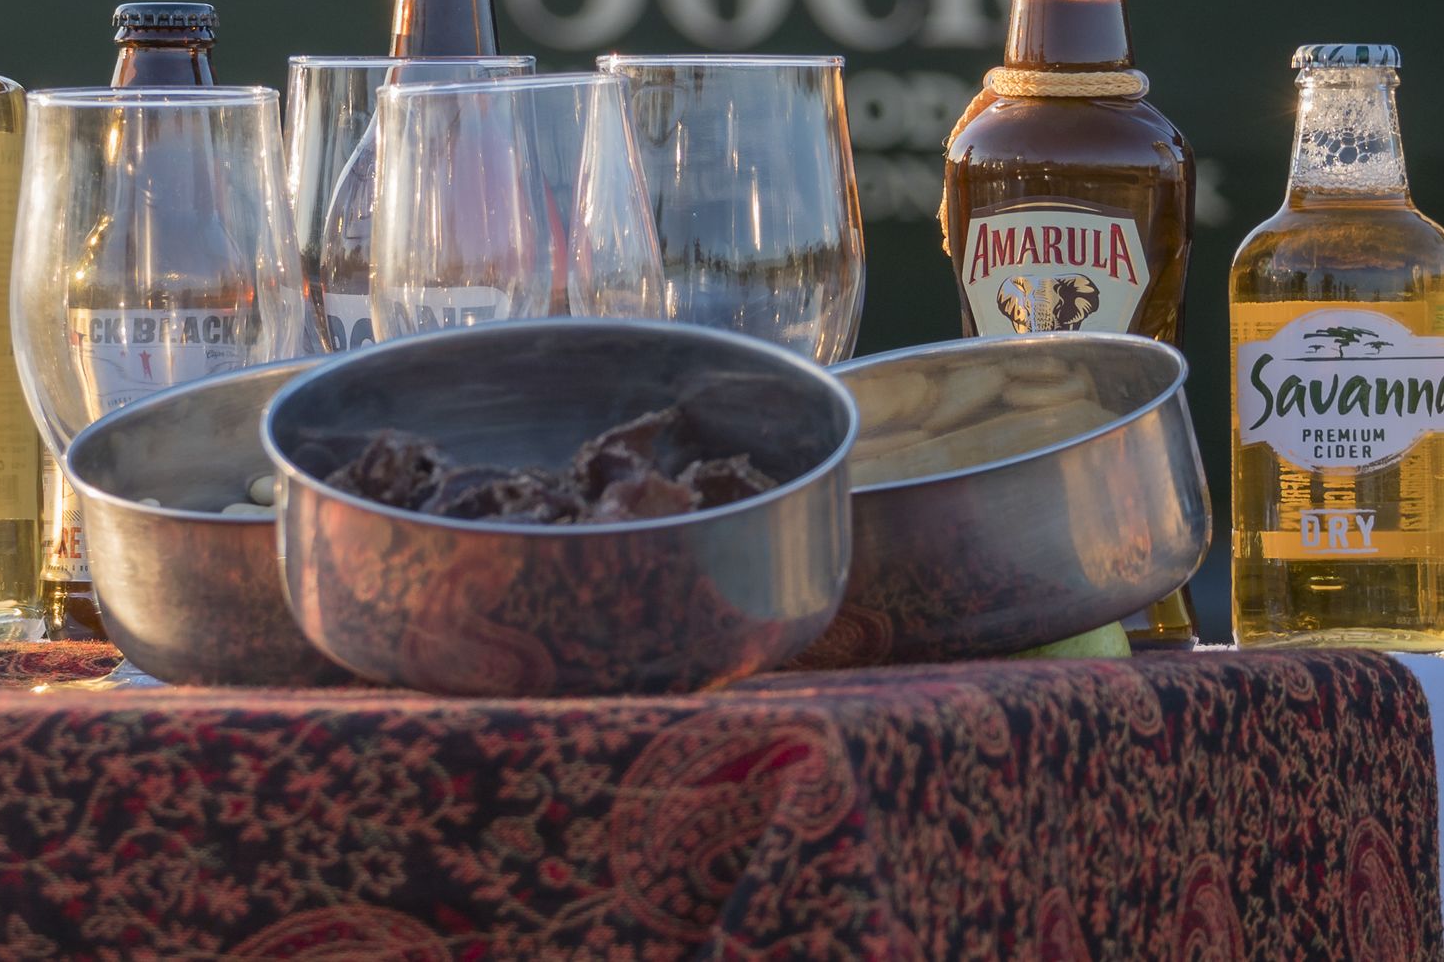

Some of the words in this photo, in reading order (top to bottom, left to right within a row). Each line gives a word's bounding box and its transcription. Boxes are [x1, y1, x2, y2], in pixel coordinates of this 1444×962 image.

[969, 222, 1138, 286] AMARULA
[1302, 428, 1385, 443] PREMIUM
[1313, 445, 1373, 459] CIDER
[1301, 515, 1375, 547] DRY
